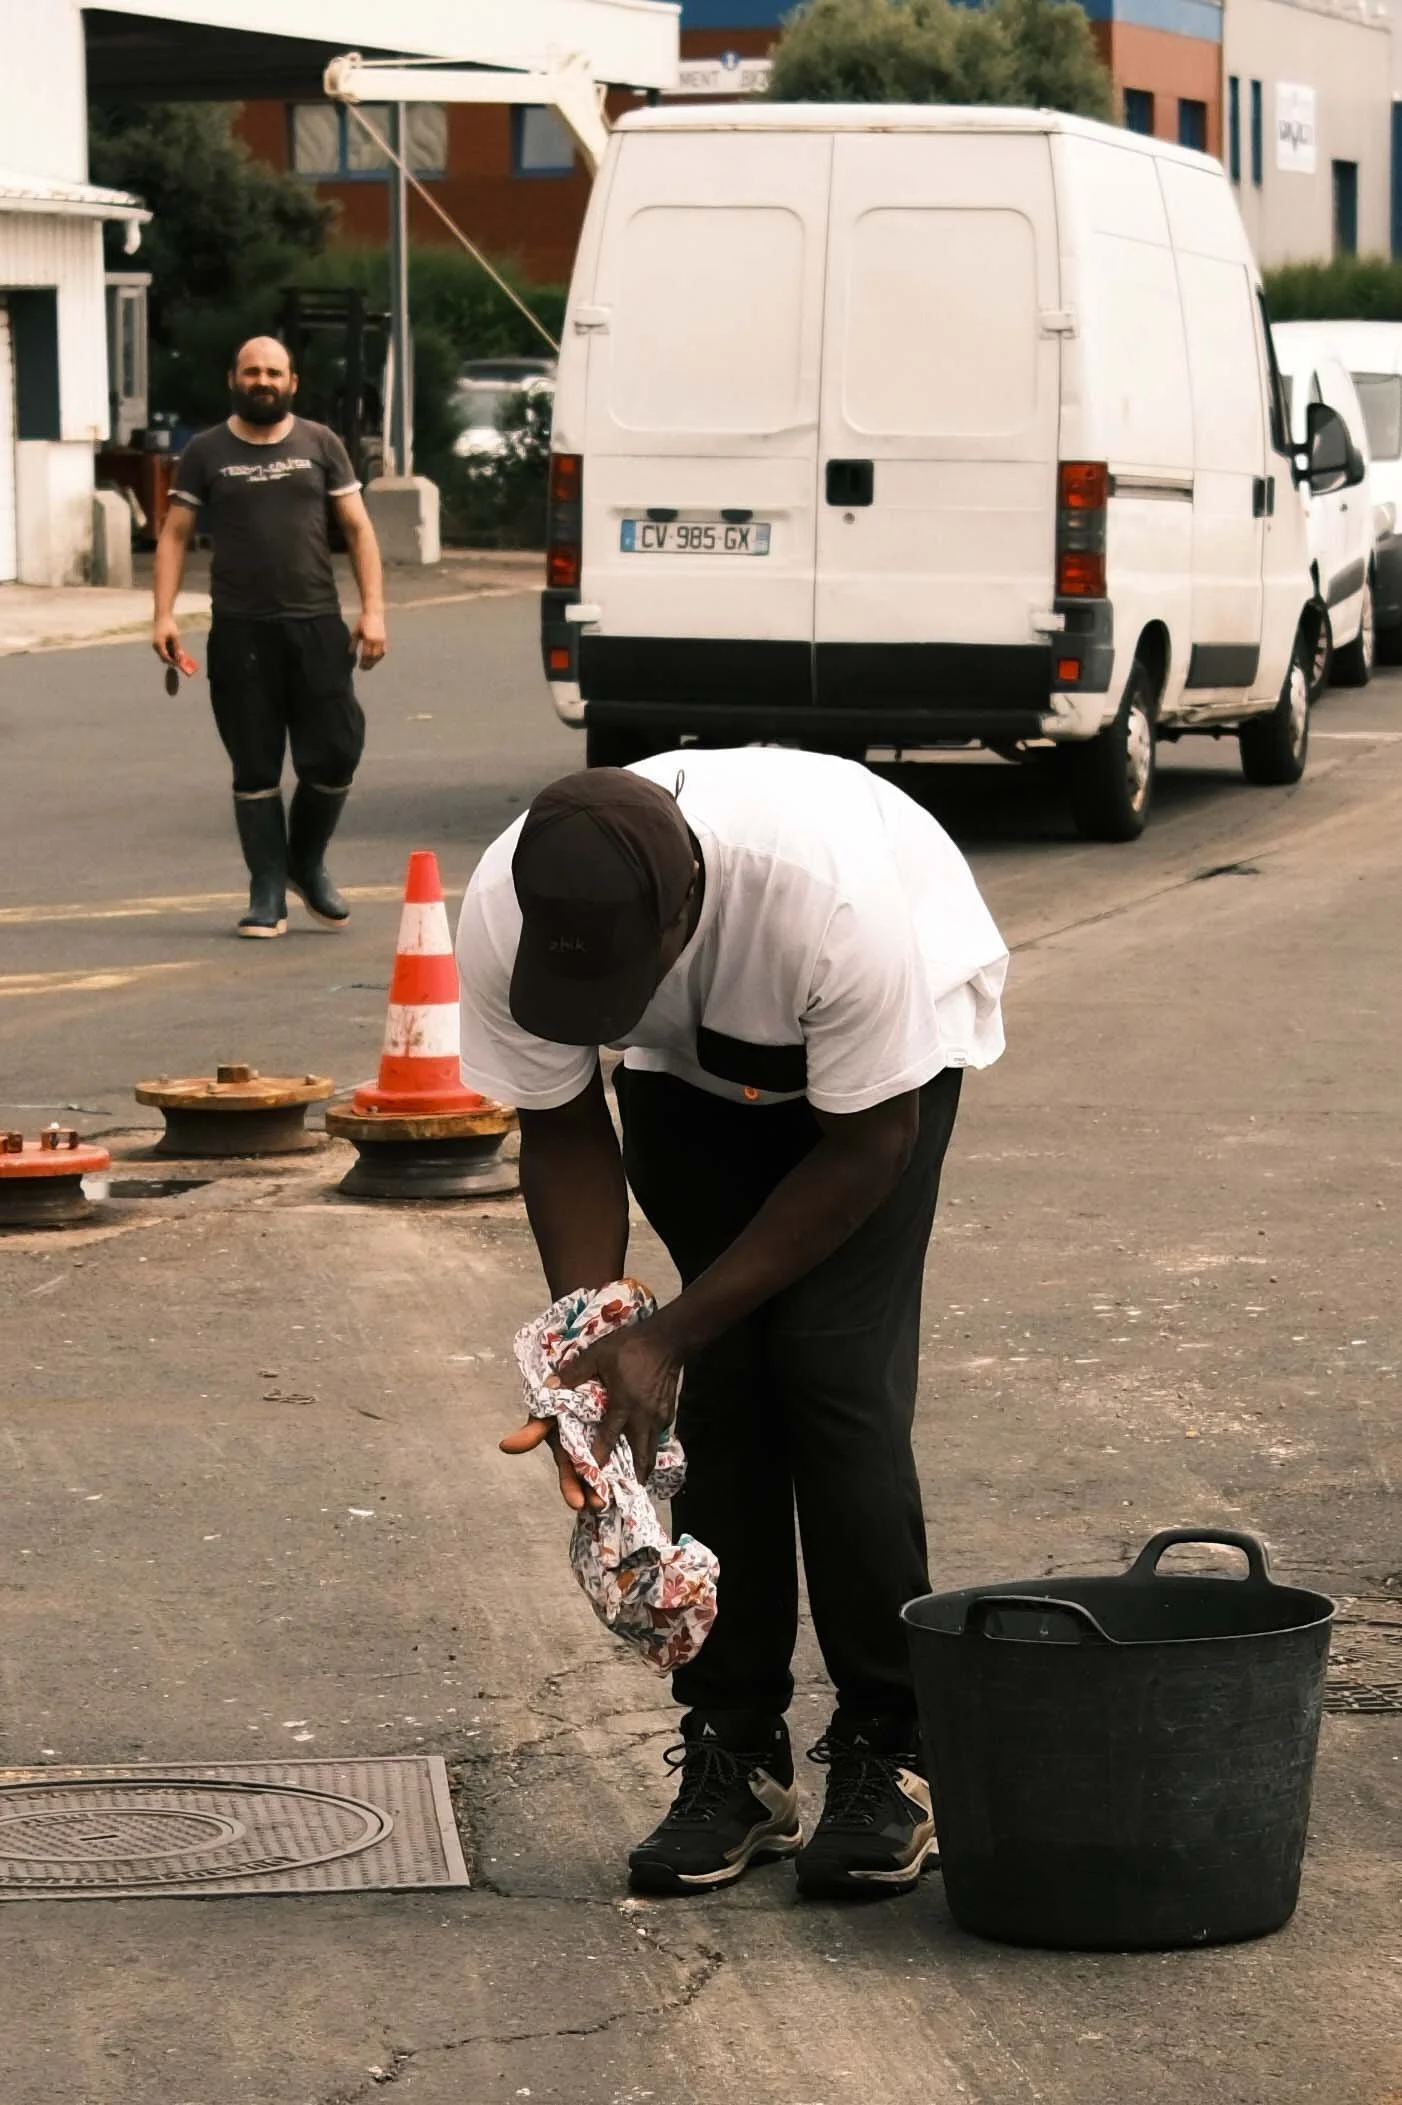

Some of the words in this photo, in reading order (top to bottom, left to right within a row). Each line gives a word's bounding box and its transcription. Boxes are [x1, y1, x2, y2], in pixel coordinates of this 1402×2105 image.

[641, 525, 668, 549] CV
[676, 525, 716, 550] 985
[724, 527, 751, 551] GX
